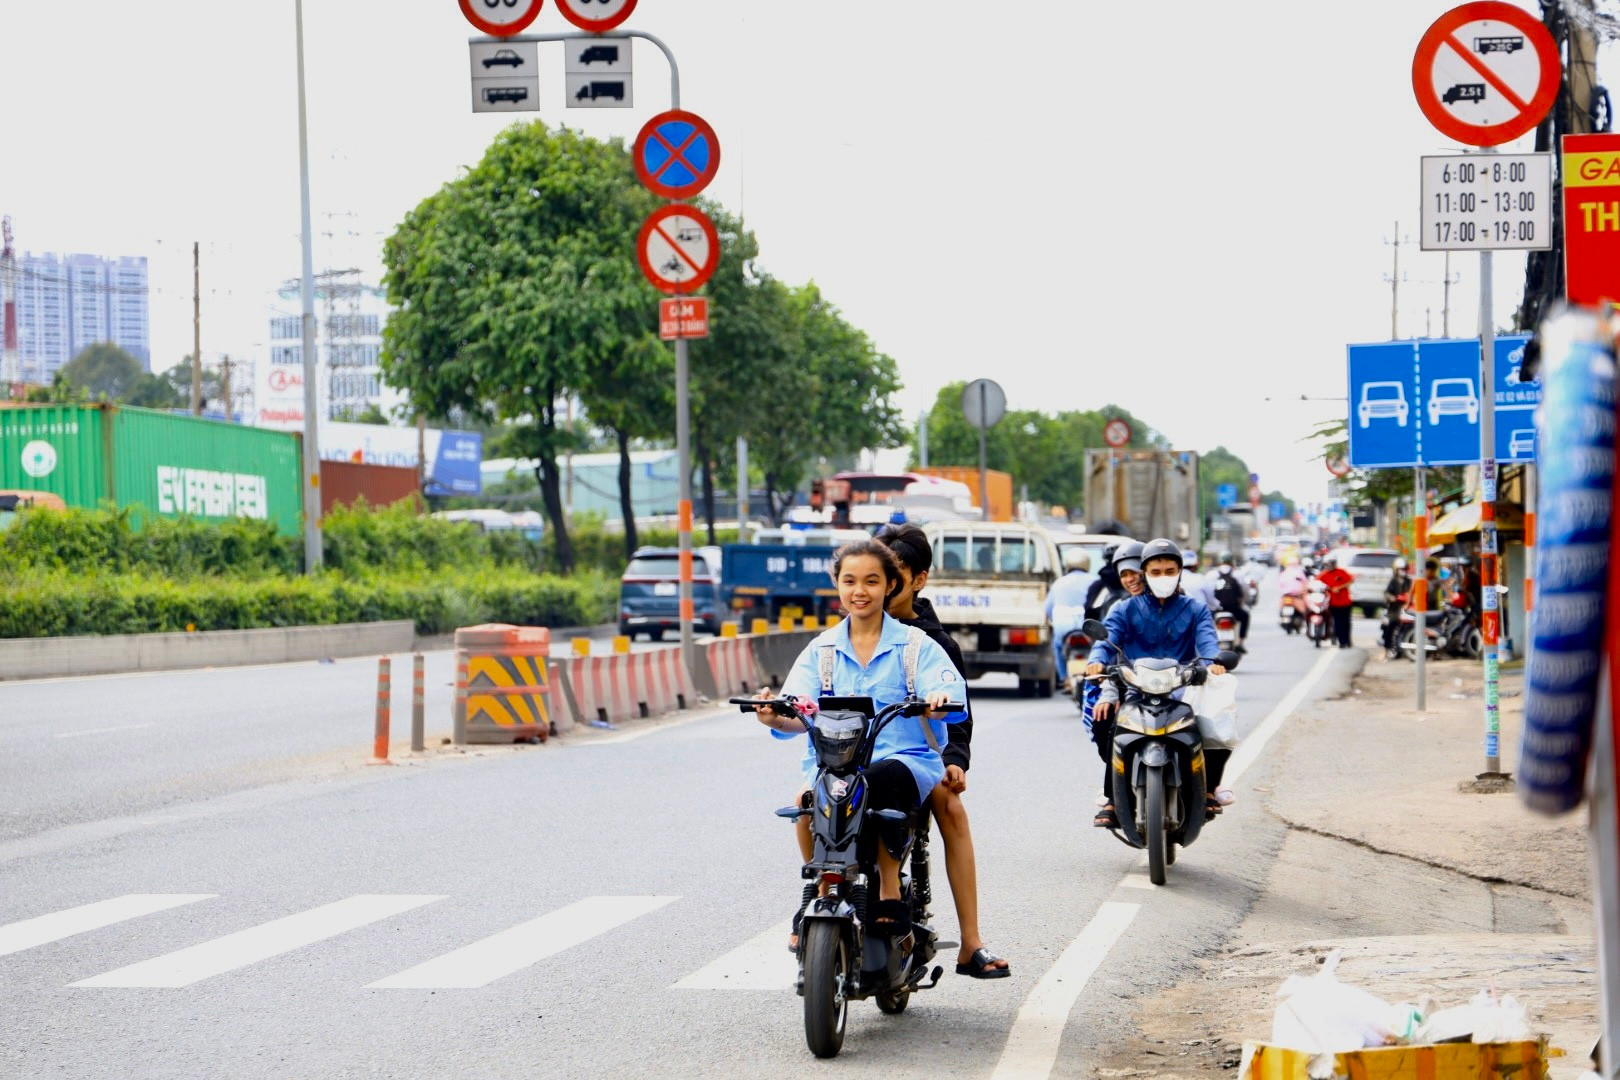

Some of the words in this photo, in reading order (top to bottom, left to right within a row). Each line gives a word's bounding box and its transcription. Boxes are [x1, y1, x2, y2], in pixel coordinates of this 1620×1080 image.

[1443, 163, 1475, 184] 6:00
[1493, 162, 1526, 183] 8:00
[1435, 192, 1476, 213] 11:00
[1494, 191, 1535, 212] 13:00
[1579, 201, 1620, 233] TH
[1435, 221, 1476, 242] 17:00
[1494, 220, 1535, 241] 19:00
[157, 465, 268, 519] EVERGREEN
